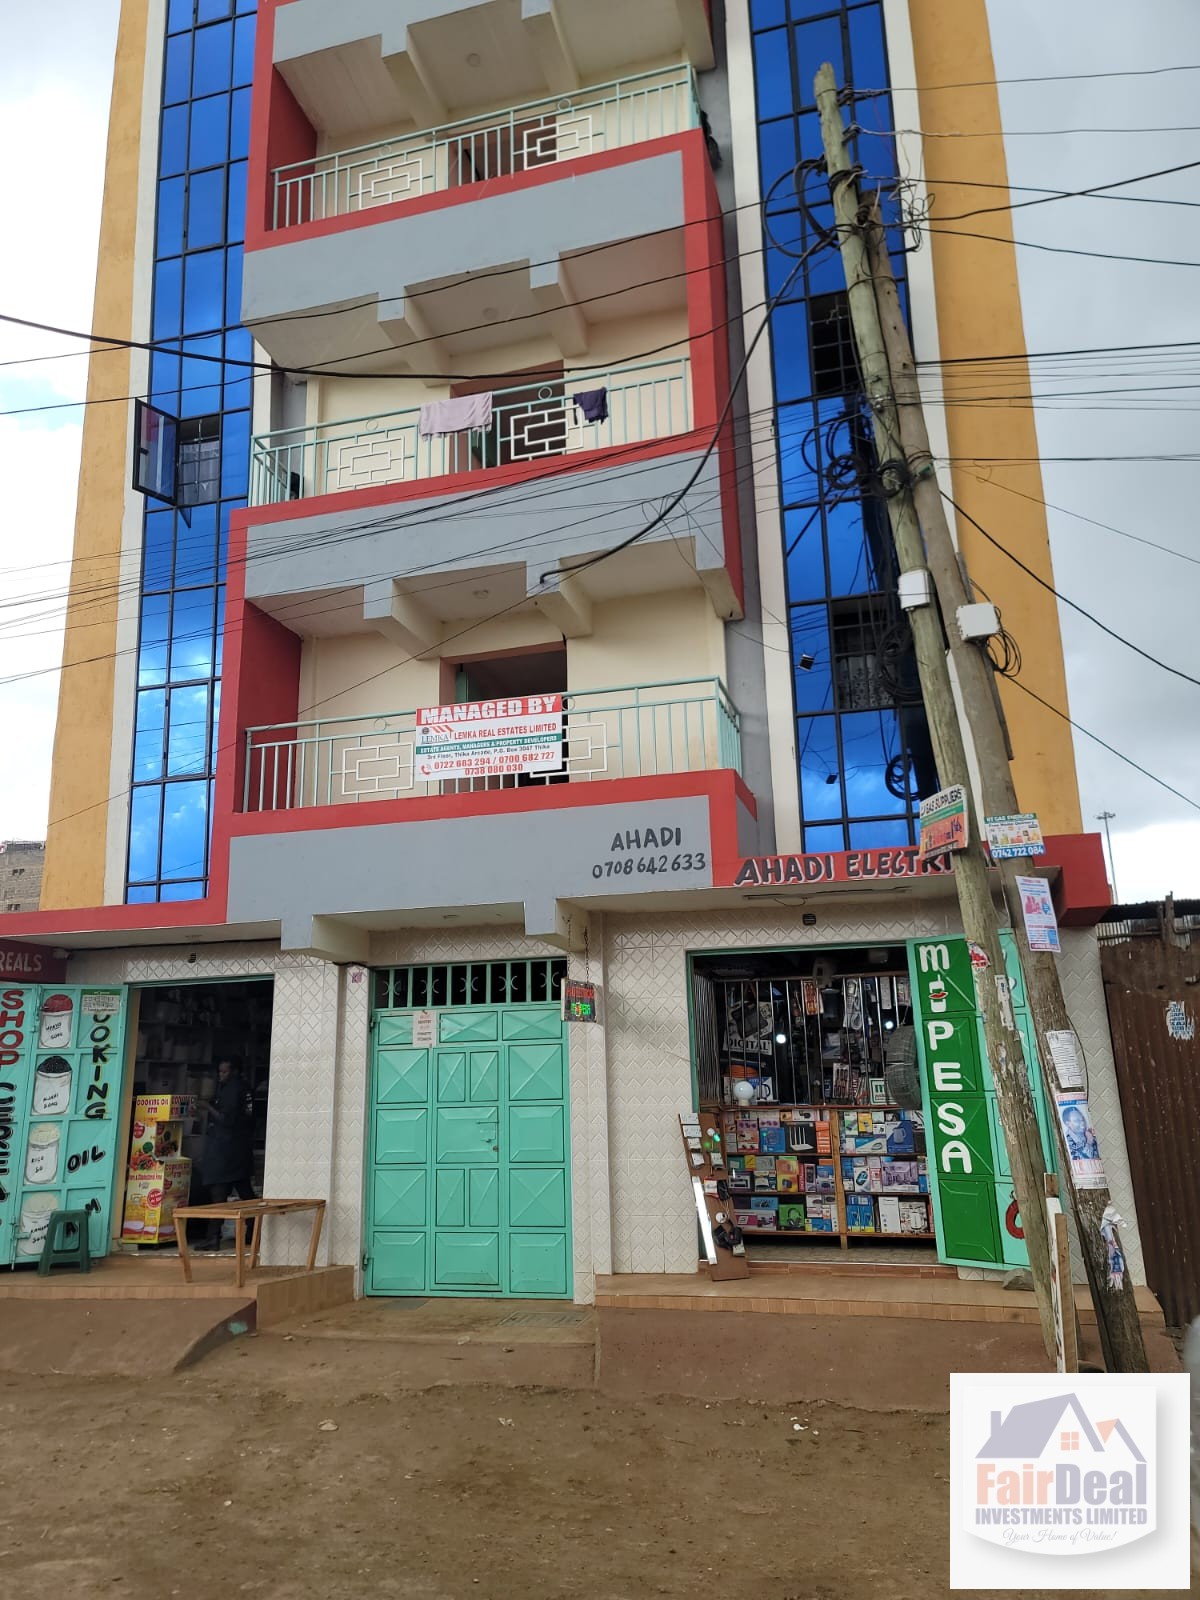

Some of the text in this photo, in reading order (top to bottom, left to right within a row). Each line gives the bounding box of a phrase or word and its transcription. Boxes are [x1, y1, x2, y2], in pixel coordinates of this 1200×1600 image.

[421, 695, 557, 725] MANAGED BY
[454, 722, 557, 740] LEMKA REAL ESTATES LIMITED
[611, 827, 681, 852] AHADI
[734, 855, 835, 887] AHADI
[67, 1145, 105, 1173] OIL
